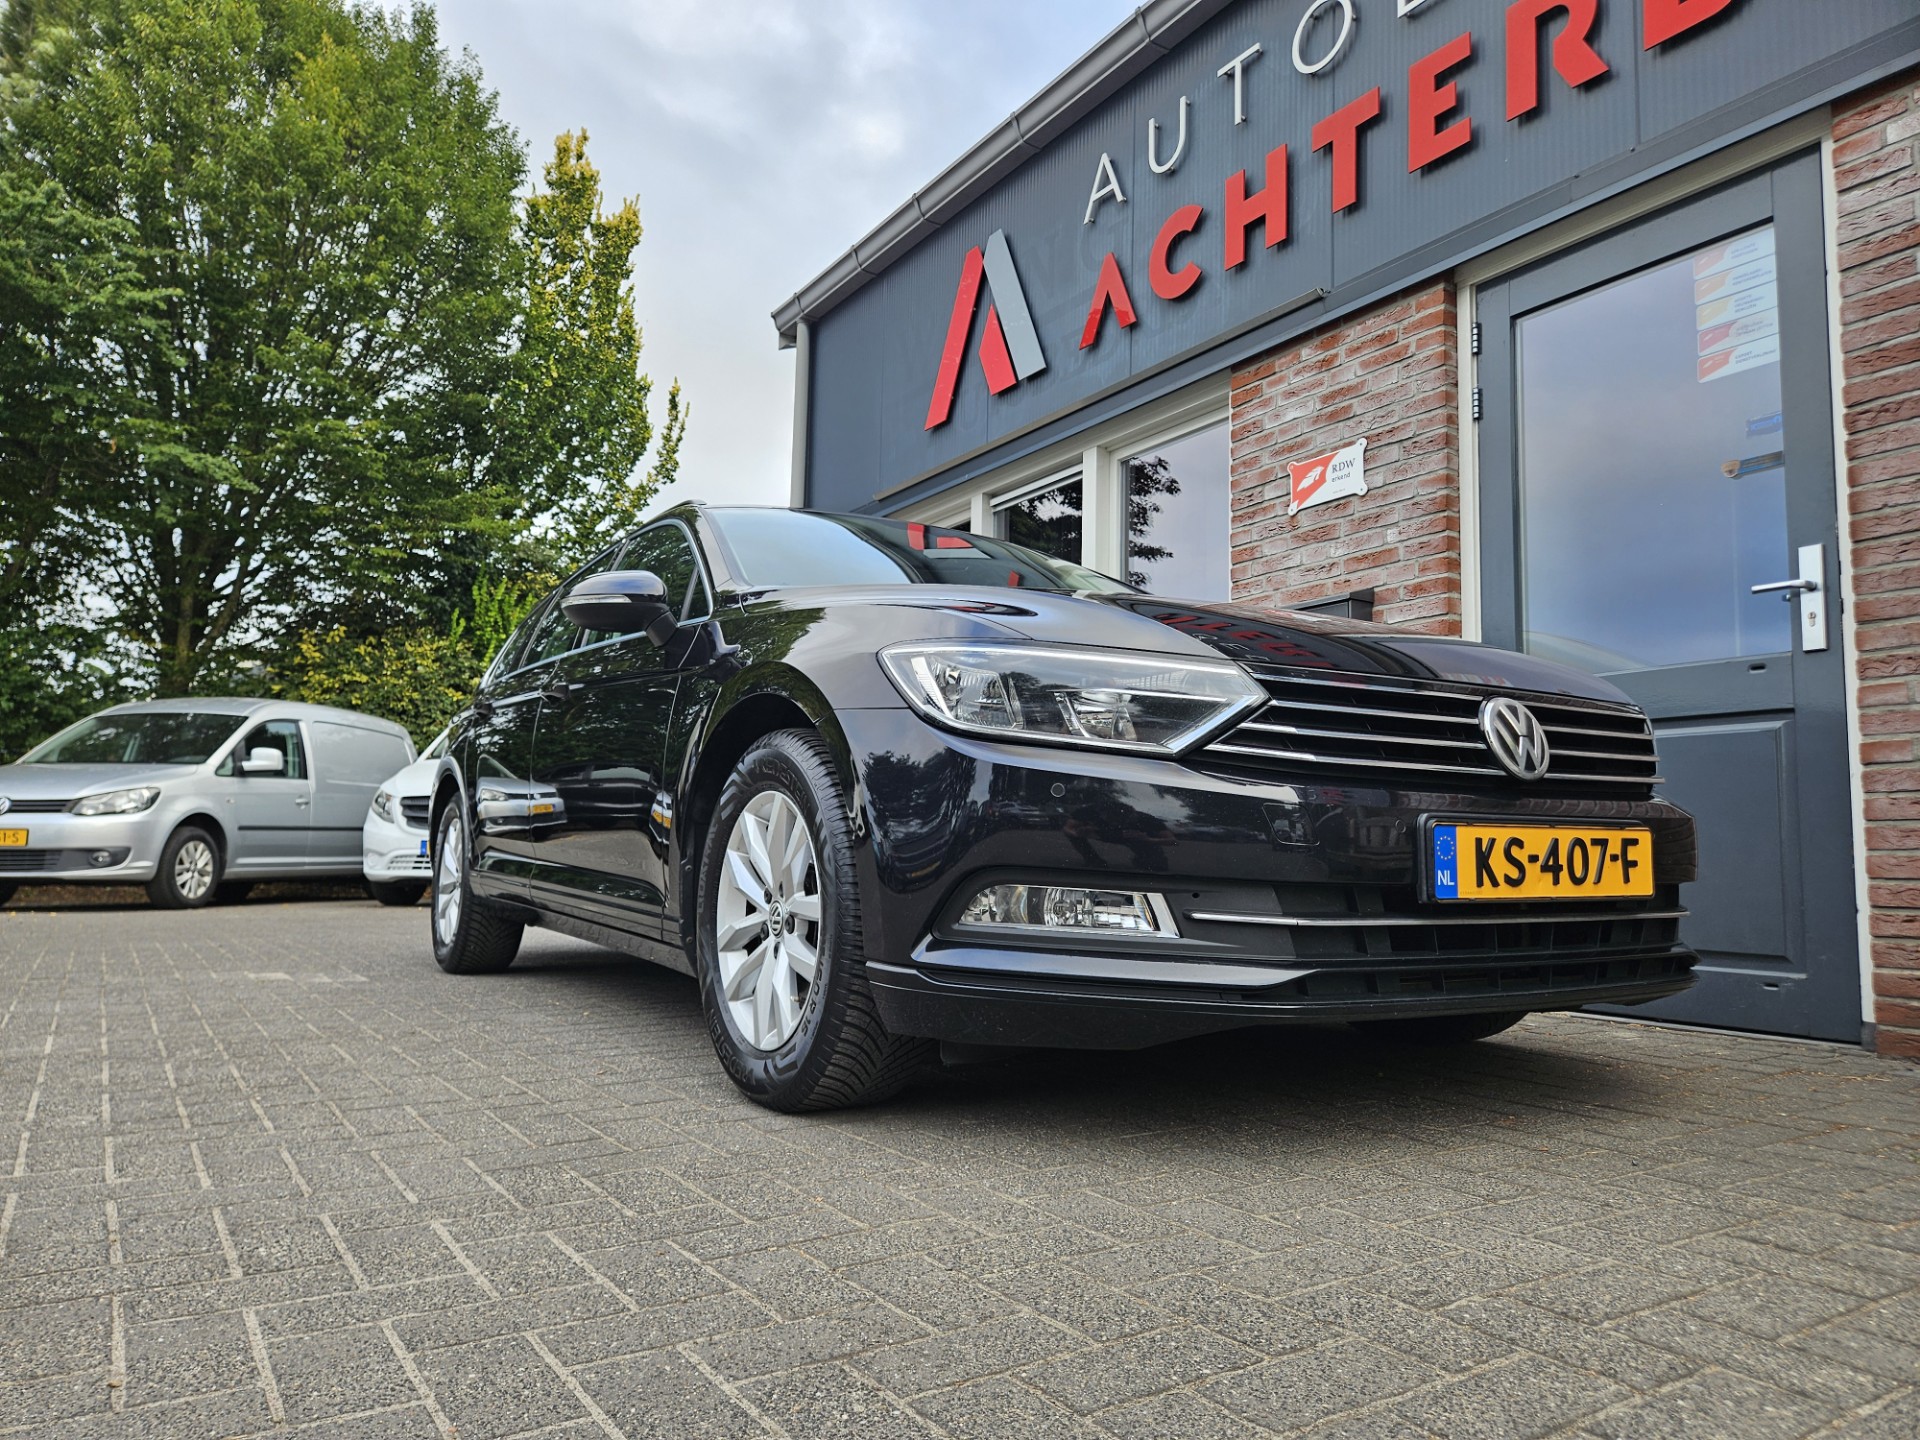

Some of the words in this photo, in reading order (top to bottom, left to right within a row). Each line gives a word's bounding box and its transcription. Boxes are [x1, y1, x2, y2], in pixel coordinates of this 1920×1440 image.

[1083, 0, 1427, 225] AUTO
[1332, 460, 1354, 473] RDW
[1331, 472, 1351, 482] erkend
[1474, 836, 1640, 889] KS-407-F
[1437, 870, 1455, 887] NL
